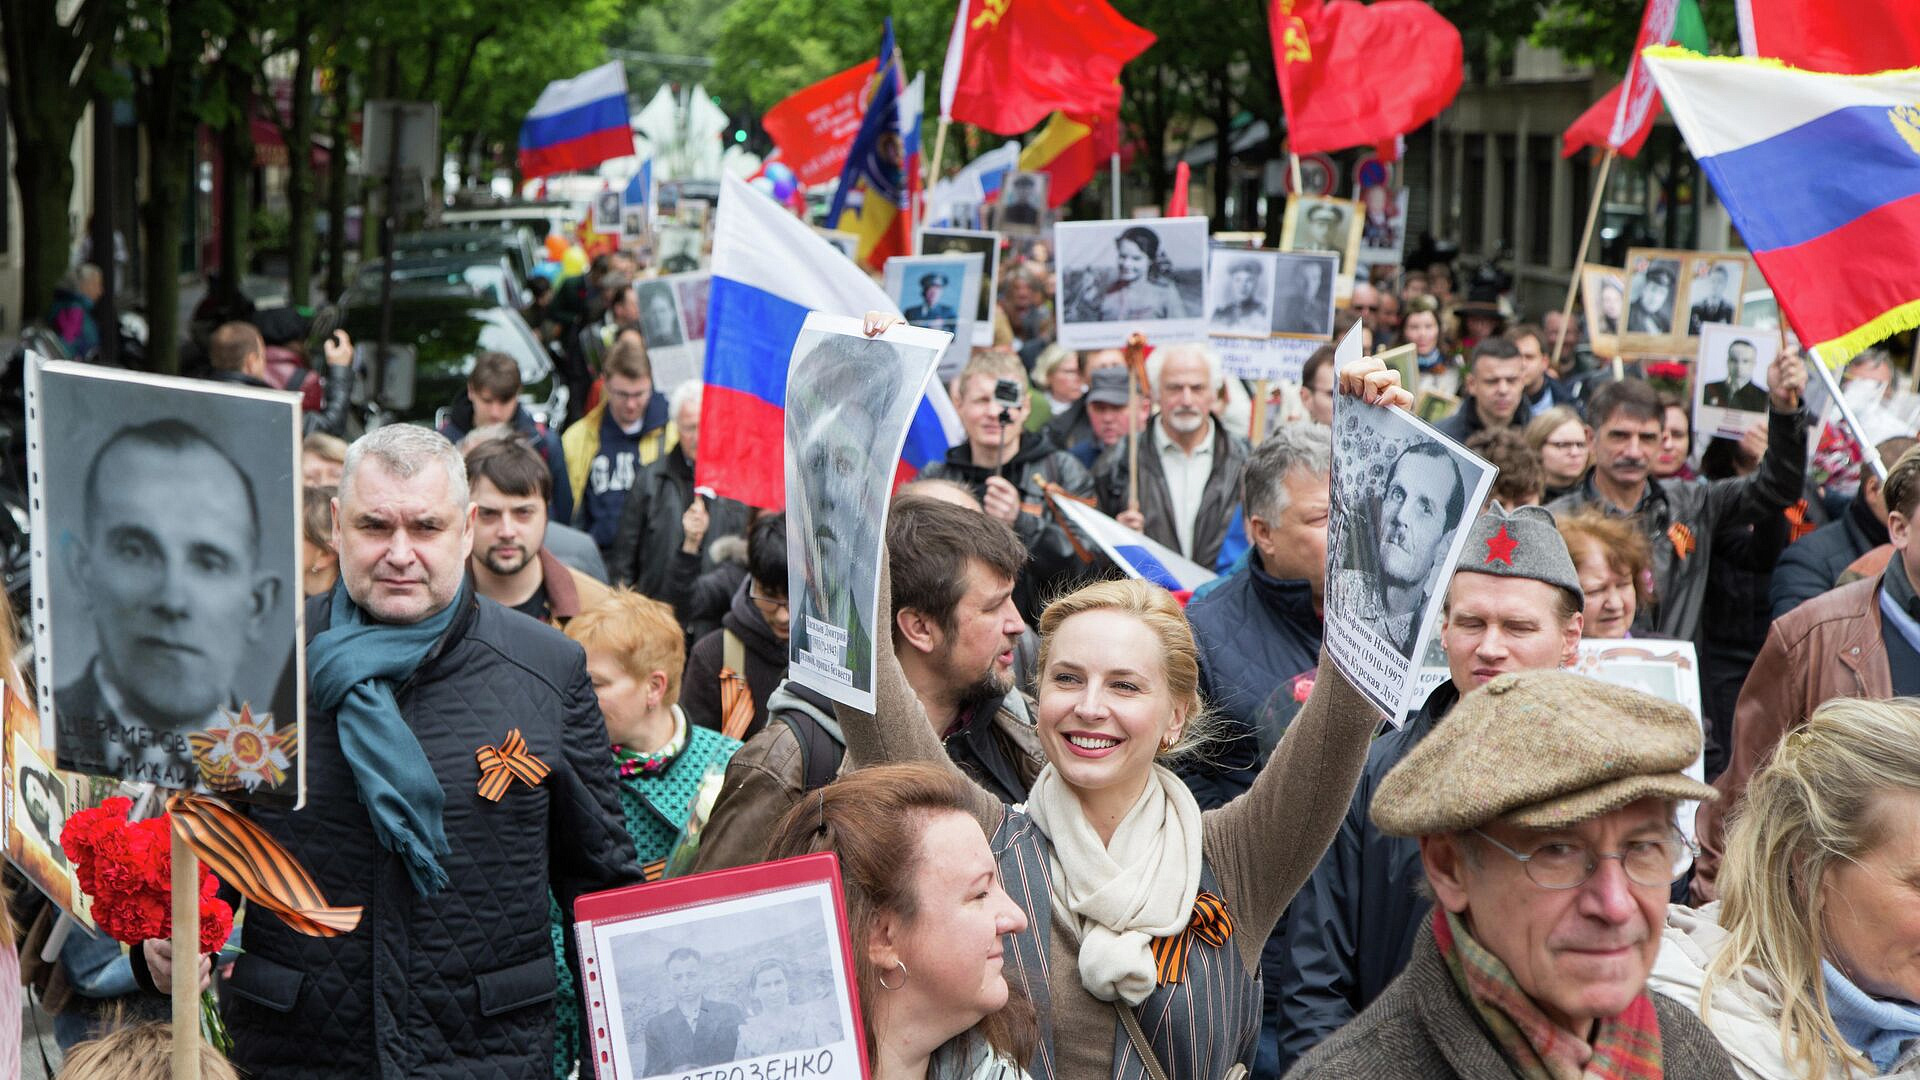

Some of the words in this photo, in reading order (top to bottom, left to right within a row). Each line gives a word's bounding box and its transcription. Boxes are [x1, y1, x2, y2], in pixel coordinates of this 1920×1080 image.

[1342, 607, 1373, 643] Кофанов
[1373, 638, 1409, 673] Николай
[1361, 647, 1405, 690] (1910-1997)
[1379, 683, 1400, 708] Дуга
[681, 1049, 833, 1080] ОЗЕНКО
